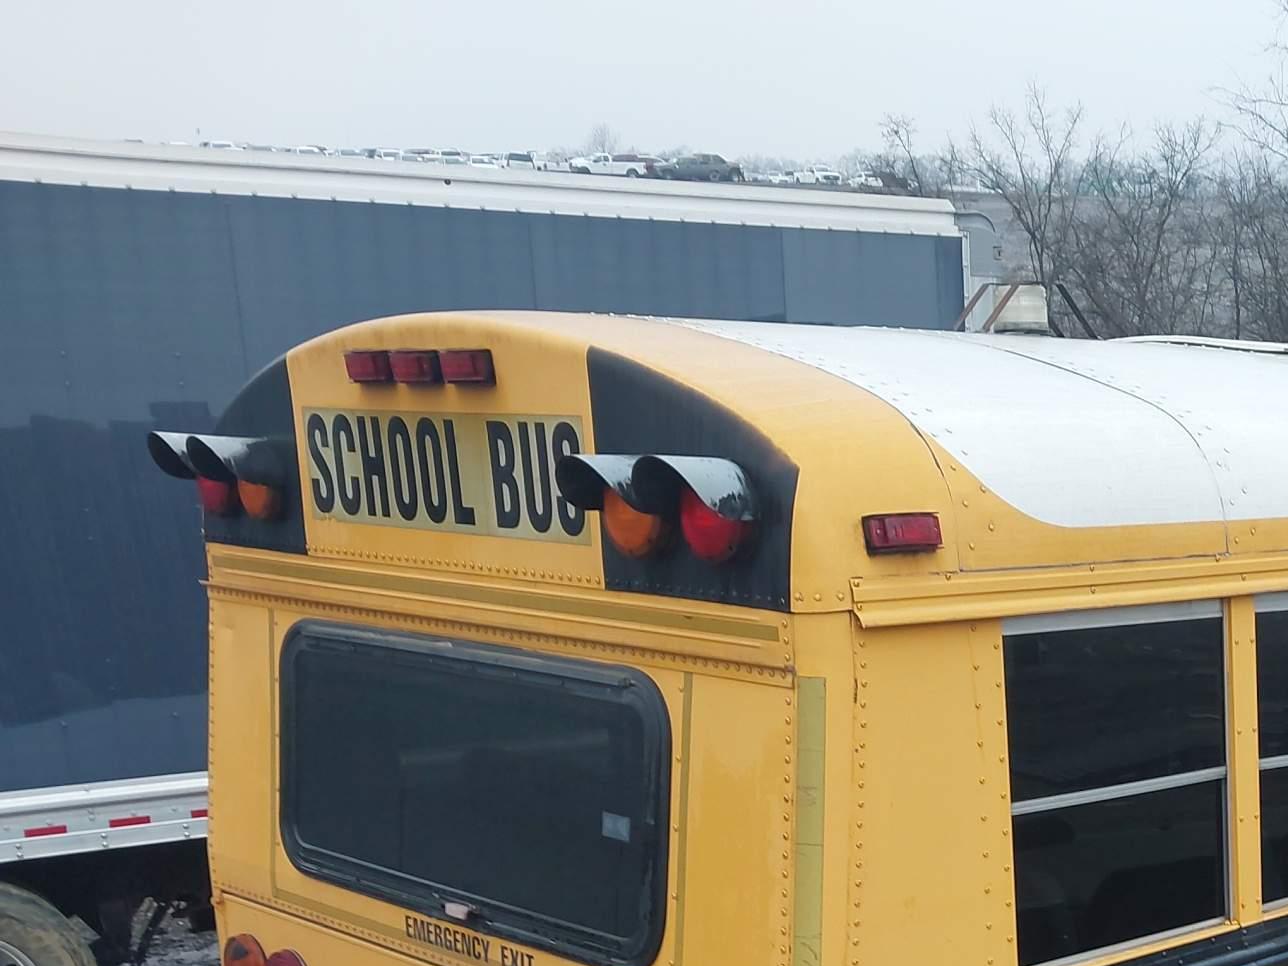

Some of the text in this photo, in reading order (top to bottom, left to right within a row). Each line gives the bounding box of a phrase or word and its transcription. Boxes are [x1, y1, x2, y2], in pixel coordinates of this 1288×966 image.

[307, 413, 586, 537] SCHOOL BUS
[404, 914, 491, 963] EMERGENCY
